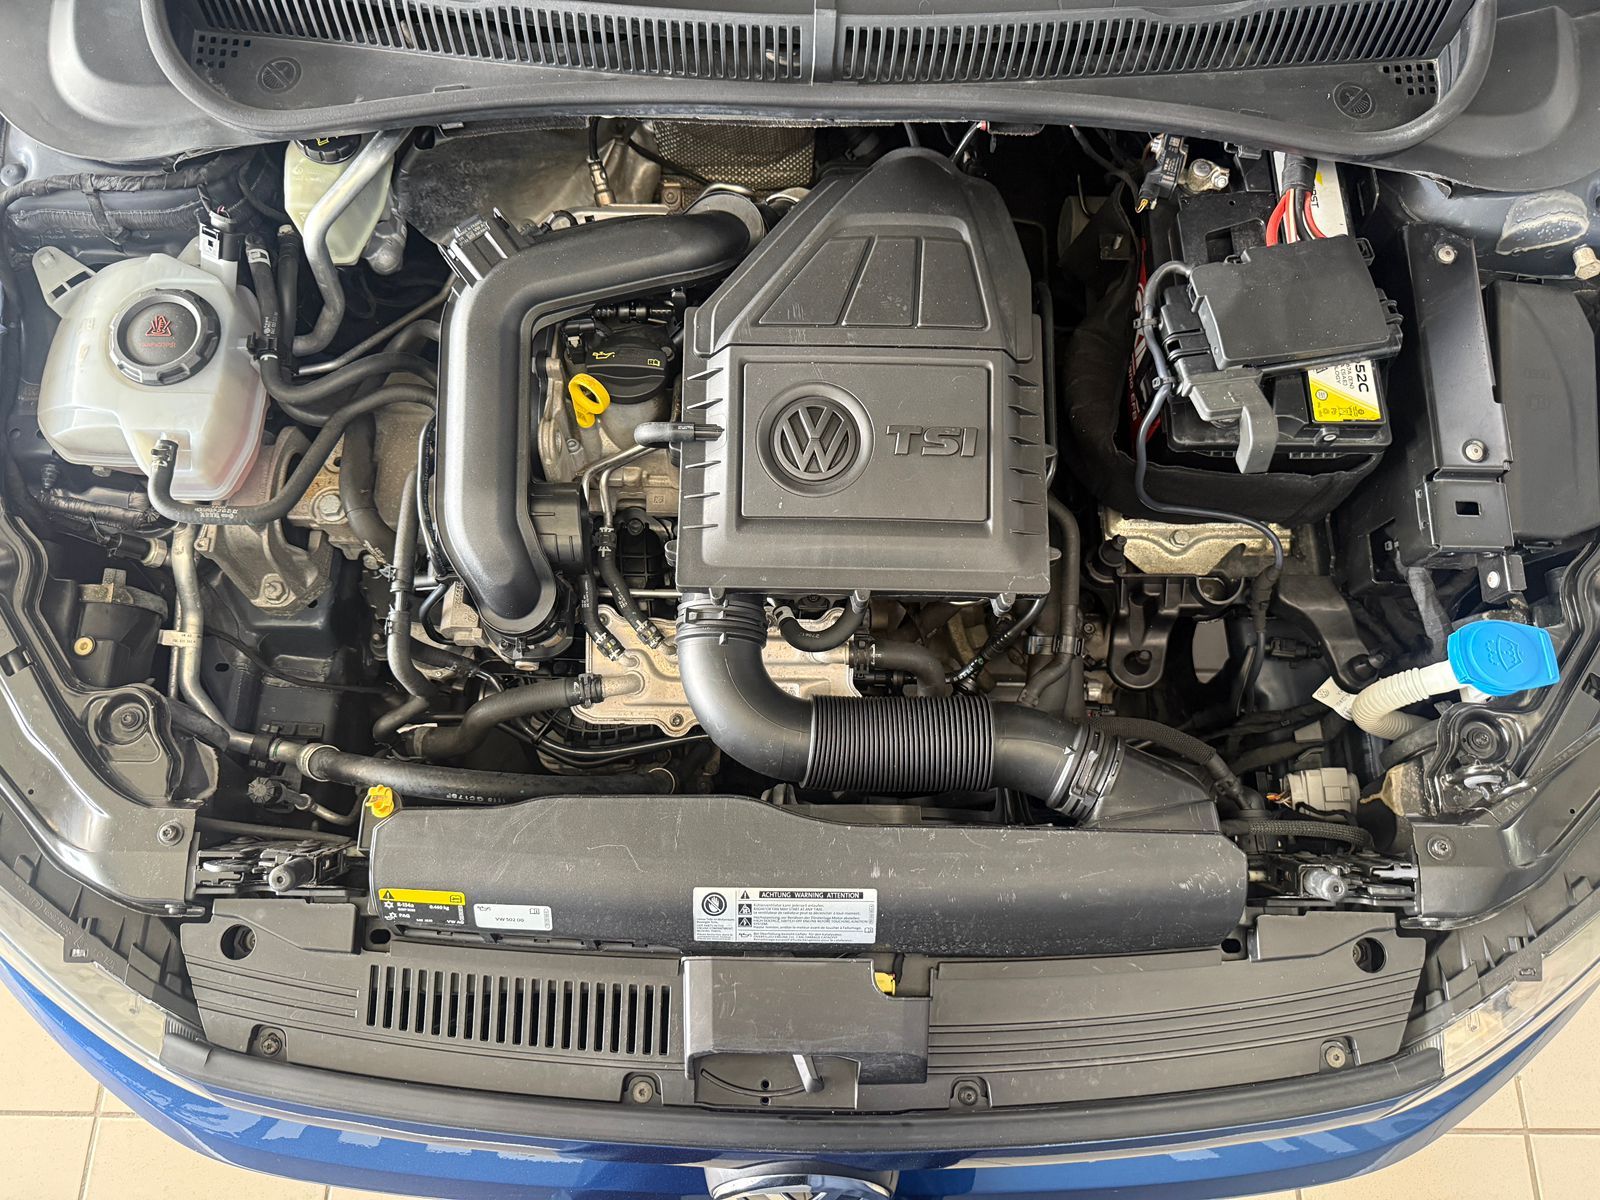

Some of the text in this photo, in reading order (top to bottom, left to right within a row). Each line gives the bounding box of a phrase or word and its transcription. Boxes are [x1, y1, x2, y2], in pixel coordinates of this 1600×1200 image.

[1355, 361, 1369, 393] 52C
[777, 400, 979, 477] VW TSI
